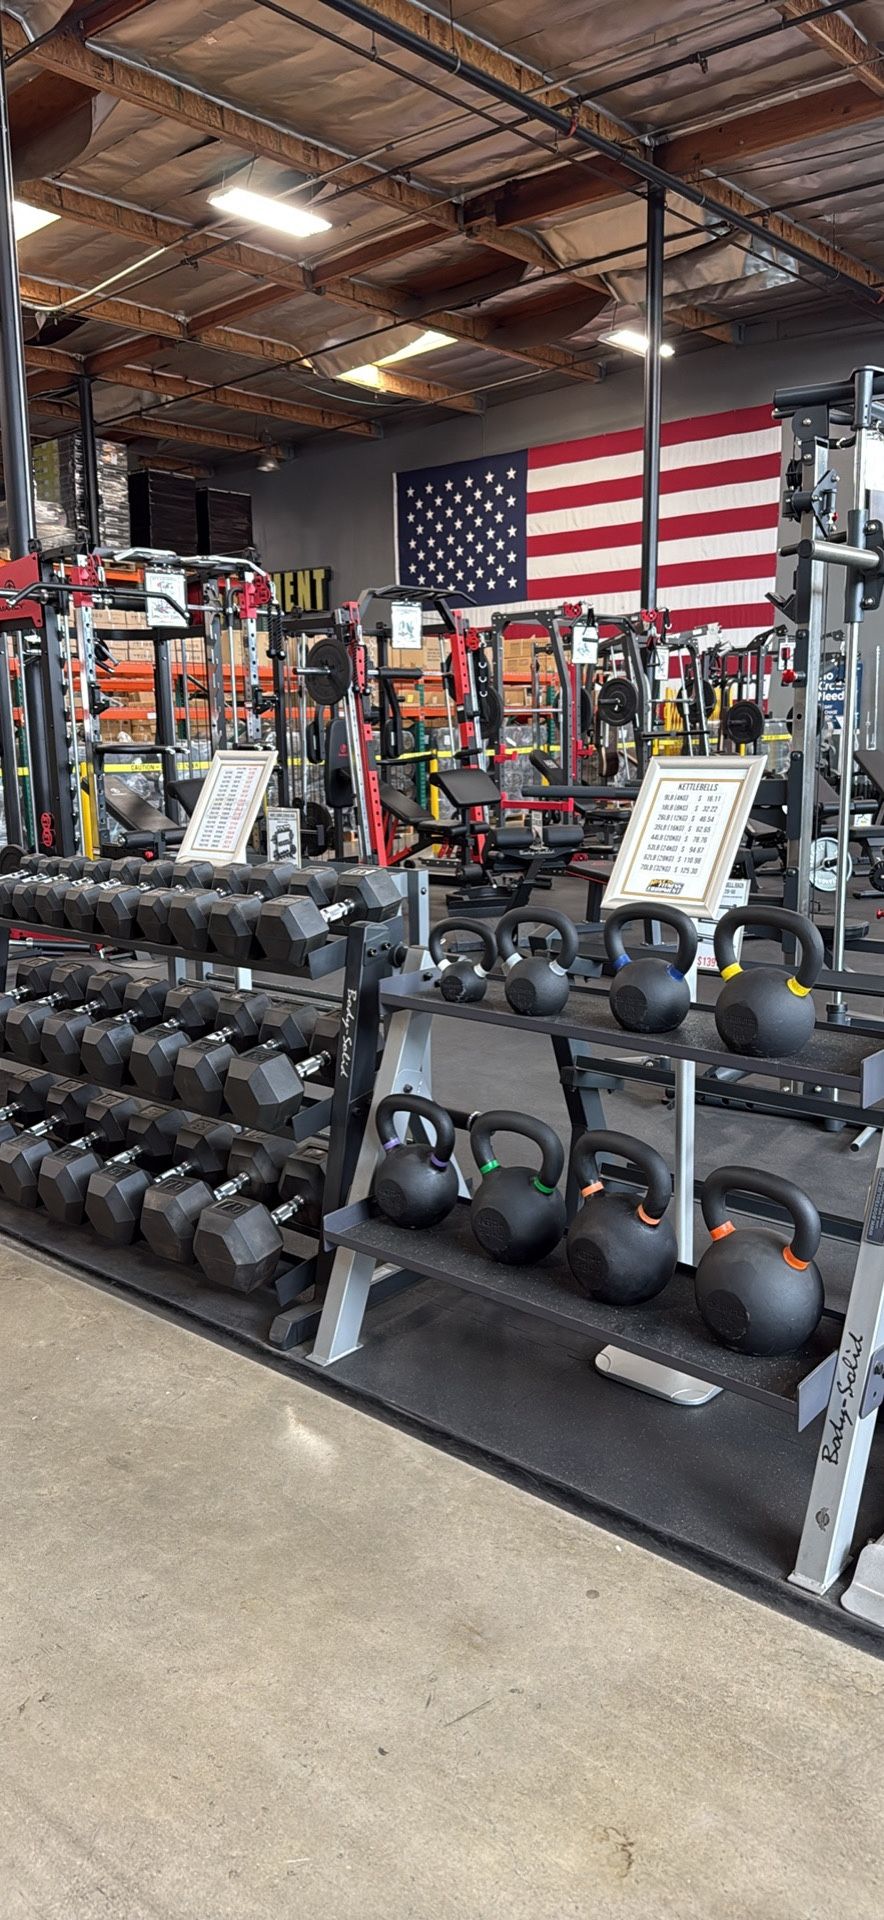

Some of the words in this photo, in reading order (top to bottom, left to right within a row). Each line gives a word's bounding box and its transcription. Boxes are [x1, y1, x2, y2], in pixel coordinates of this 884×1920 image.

[678, 783, 719, 791] KETTLEBELLS
[340, 988, 357, 1079] Body-Solid
[822, 1332, 864, 1466] Body-Solid
